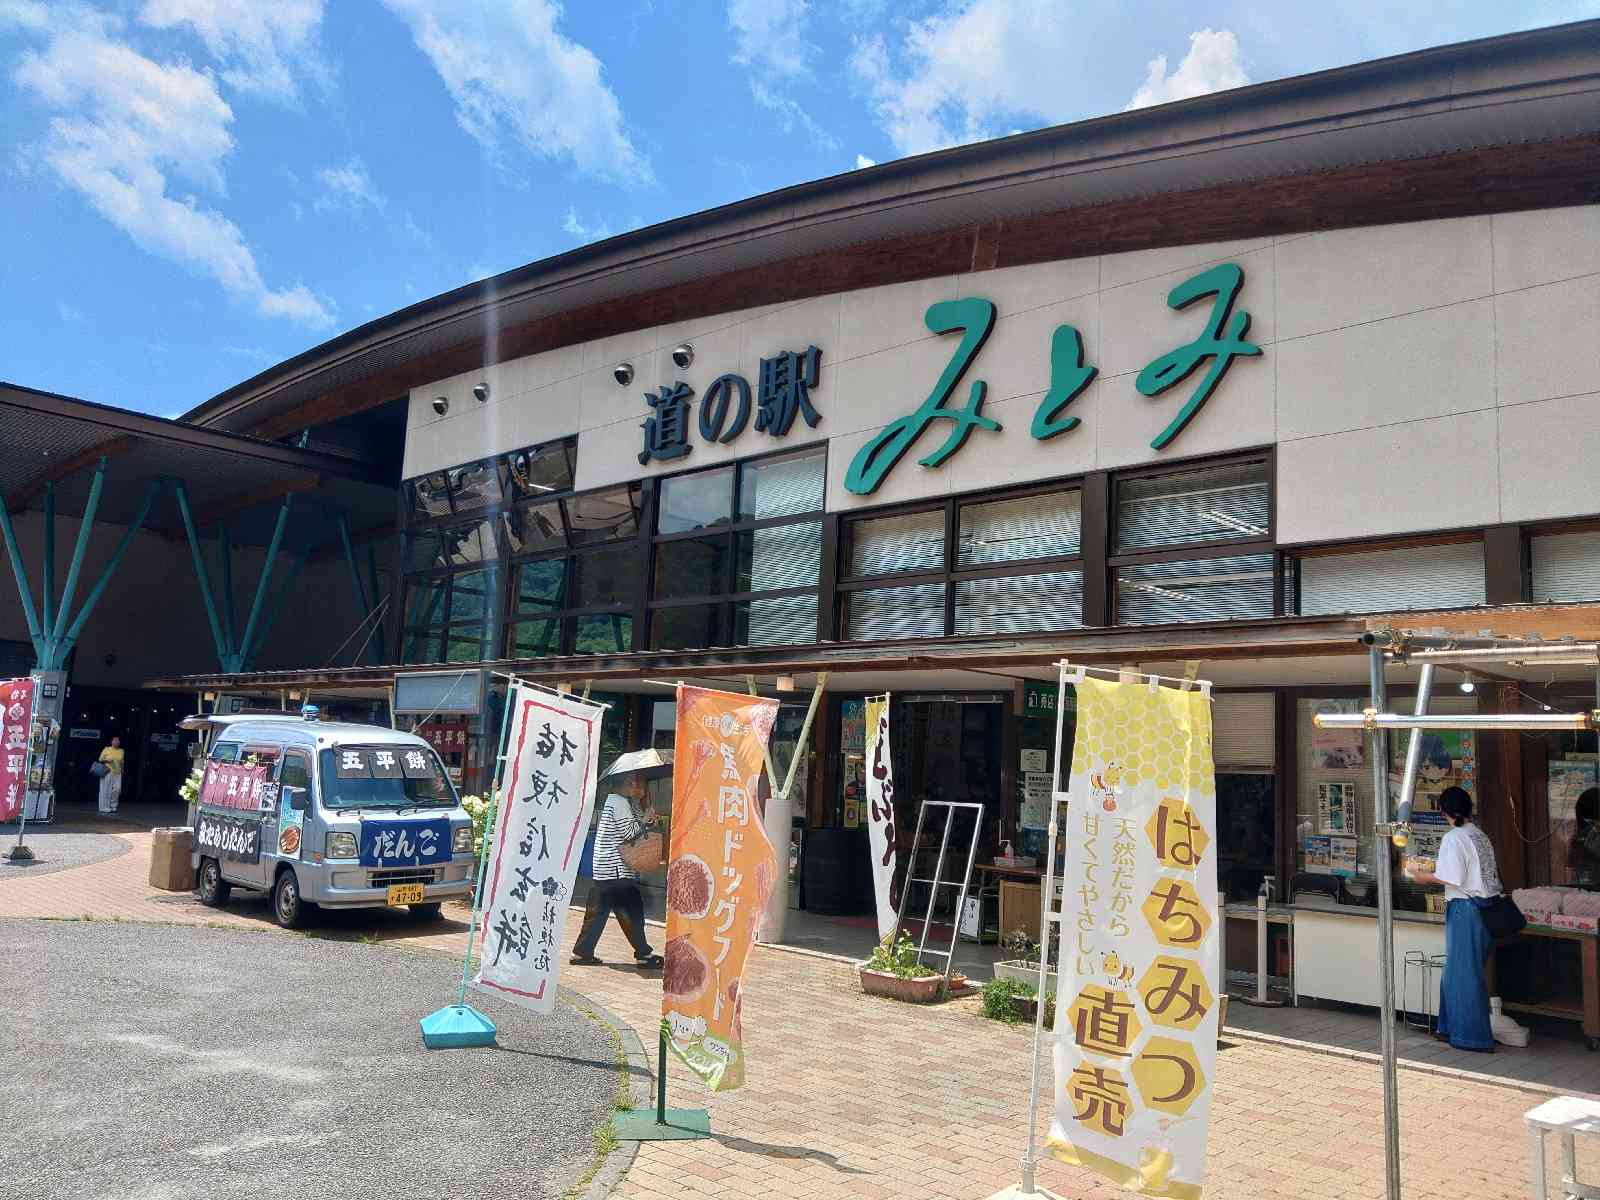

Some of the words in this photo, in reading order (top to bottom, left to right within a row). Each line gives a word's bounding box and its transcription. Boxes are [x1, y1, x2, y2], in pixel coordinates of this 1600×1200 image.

[638, 344, 823, 466] 道の駅
[843, 262, 1264, 496] みとみ
[342, 751, 426, 770] 五平餅
[373, 828, 440, 859] だんご
[1075, 811, 1104, 977] 甘くてやさしい
[1108, 816, 1138, 938] 天然だから
[1142, 804, 1206, 1102] はちみつ
[1072, 990, 1136, 1137] 直売
